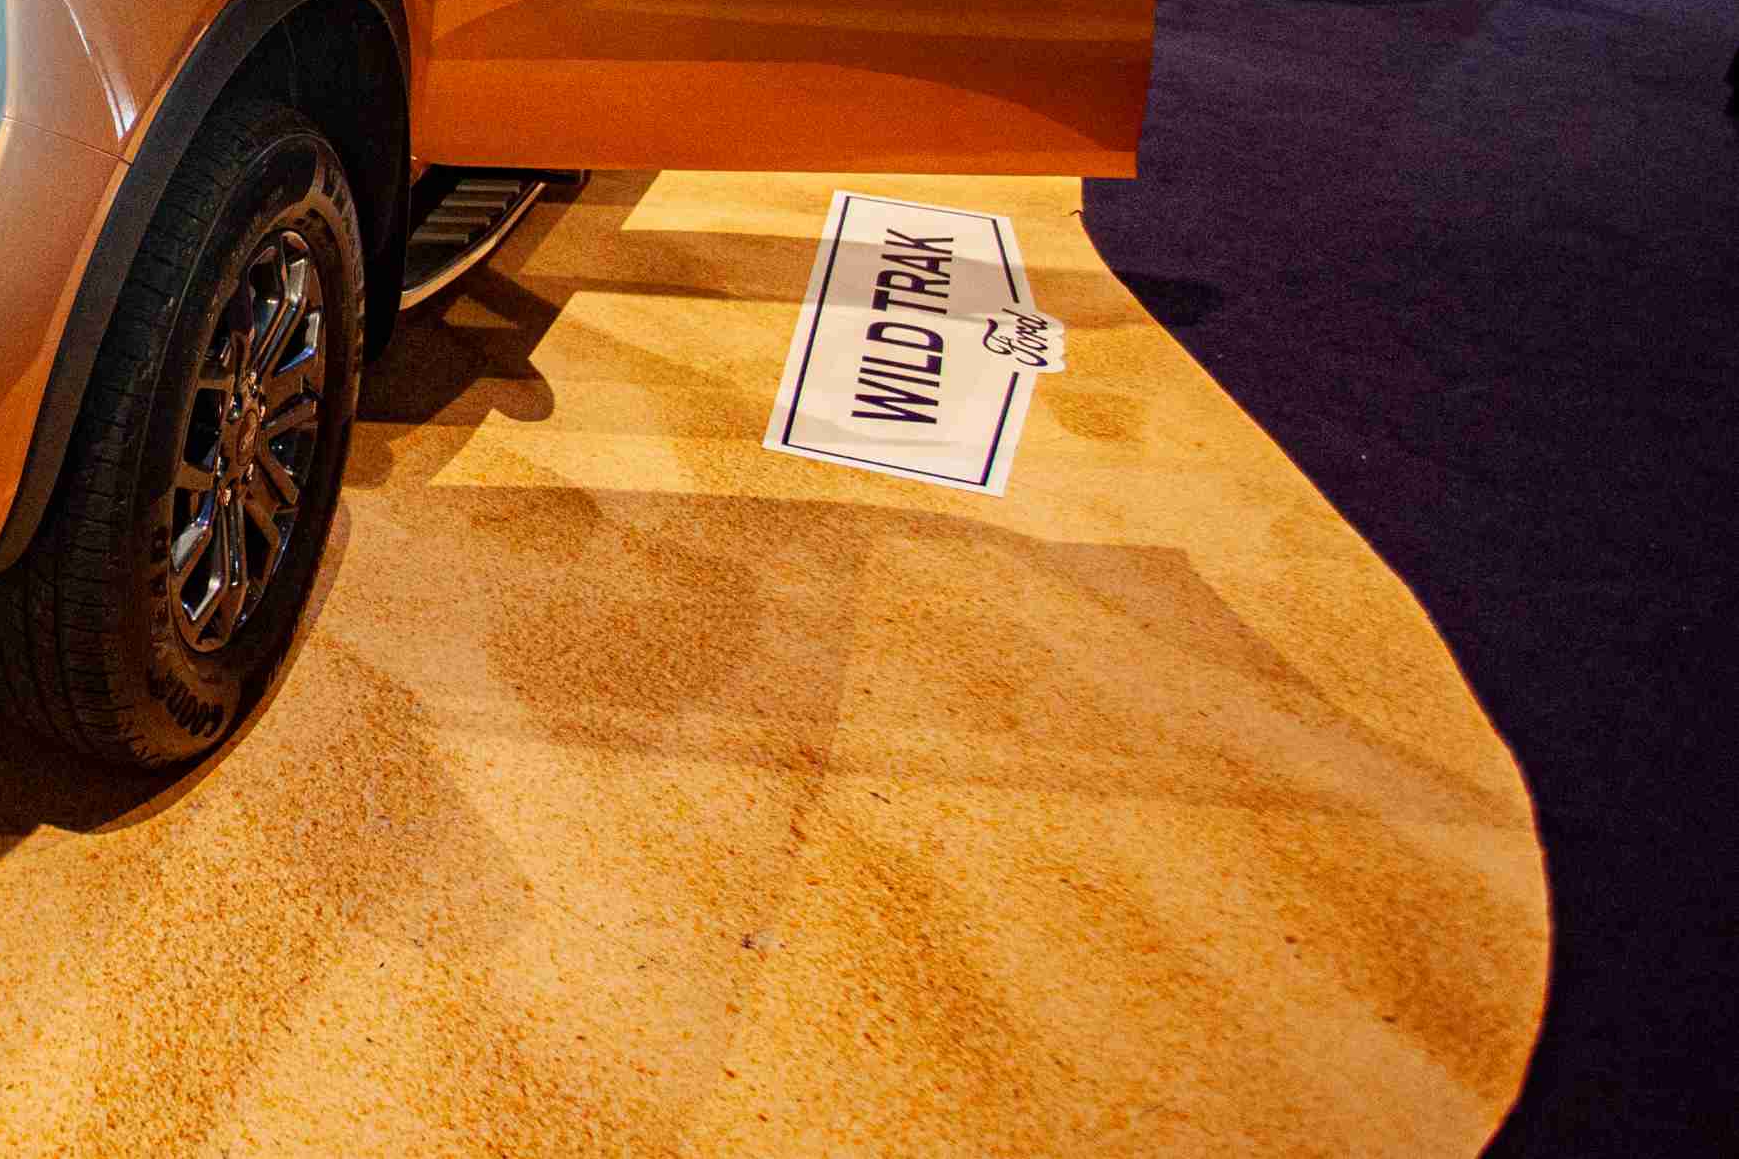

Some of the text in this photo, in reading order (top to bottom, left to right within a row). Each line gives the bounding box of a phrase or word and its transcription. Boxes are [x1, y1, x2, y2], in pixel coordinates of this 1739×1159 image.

[850, 228, 955, 425] WILD TRAK
[981, 307, 1049, 367] Ford
